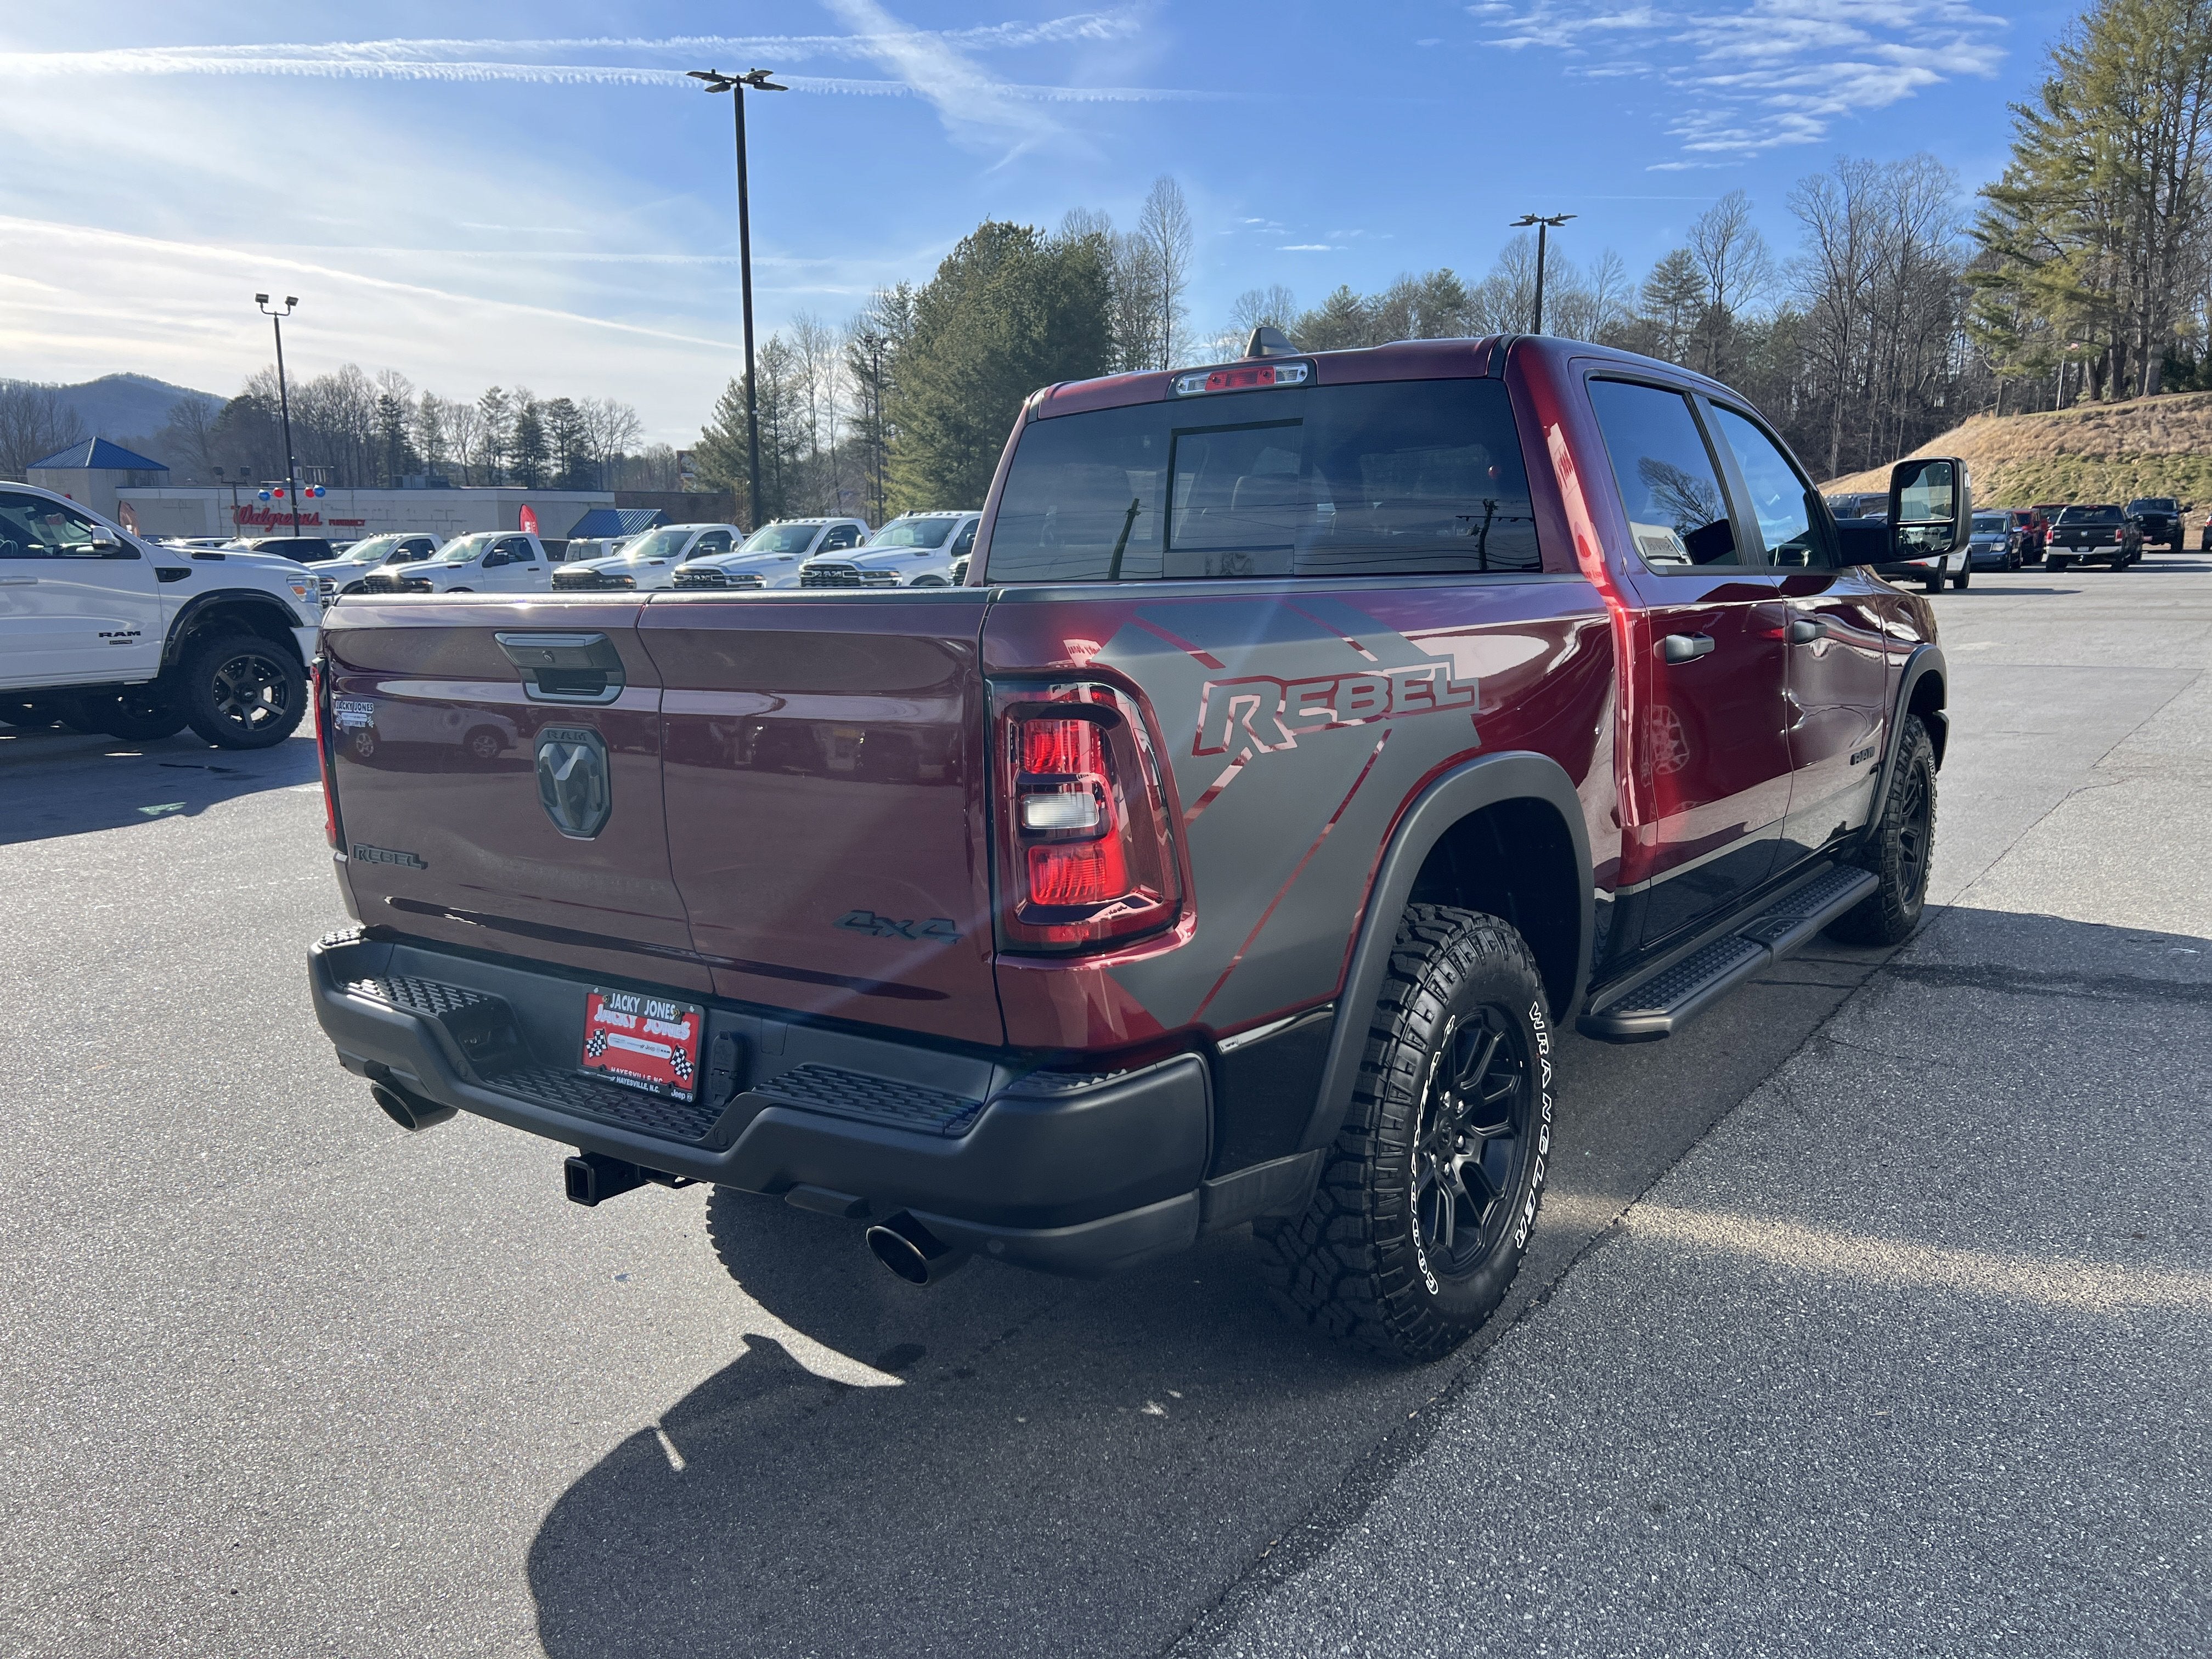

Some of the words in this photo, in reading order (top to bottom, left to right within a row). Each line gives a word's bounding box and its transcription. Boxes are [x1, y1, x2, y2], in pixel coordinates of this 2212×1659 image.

[230, 504, 323, 532] Walgrens
[336, 701, 353, 711] JACKY
[354, 702, 374, 713] JONES
[1192, 662, 1476, 758] REBEL
[547, 730, 588, 741] RAM
[1850, 746, 1875, 765] RAM
[353, 843, 428, 870] REBEL
[610, 992, 641, 1013] JACKY
[644, 1000, 676, 1021] JONES
[616, 1076, 648, 1091] HAYESVILLE,
[650, 1084, 660, 1093] N.C.
[671, 1088, 686, 1100] Jeep
[1514, 1001, 1551, 1249] WRANGLER
